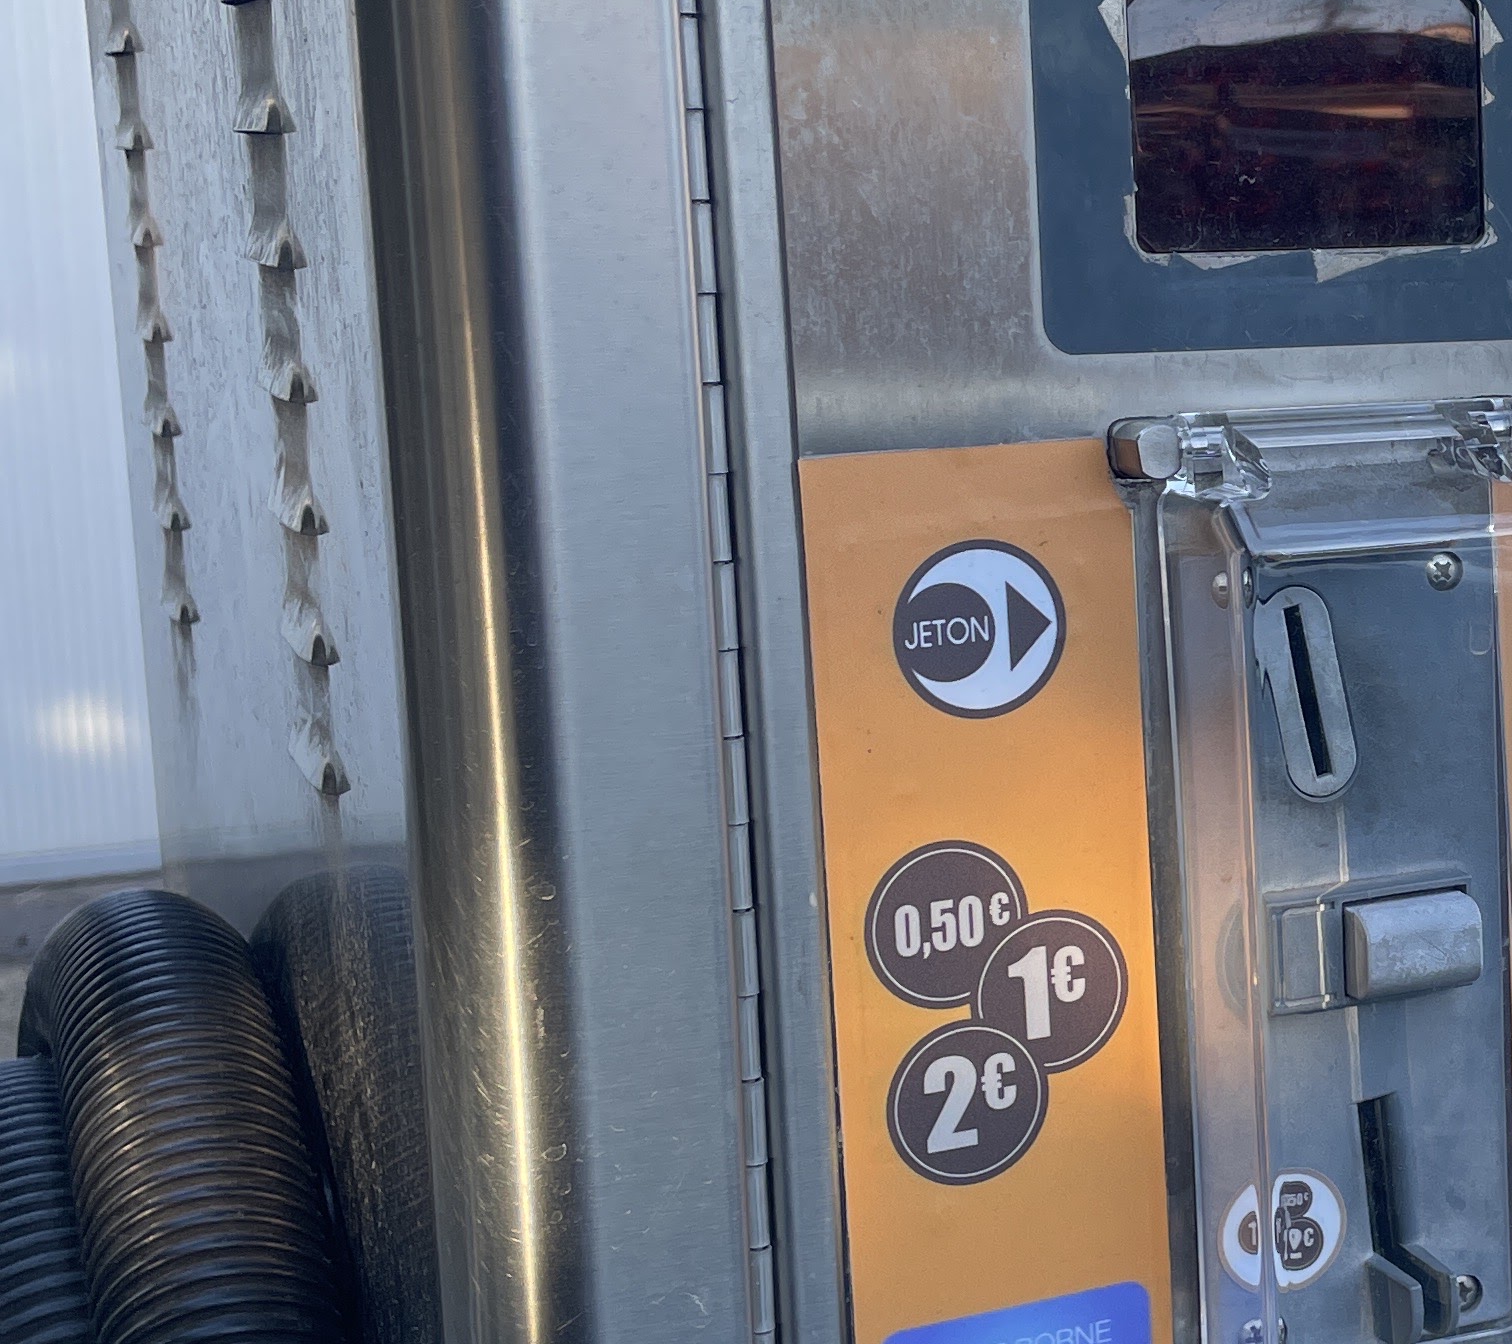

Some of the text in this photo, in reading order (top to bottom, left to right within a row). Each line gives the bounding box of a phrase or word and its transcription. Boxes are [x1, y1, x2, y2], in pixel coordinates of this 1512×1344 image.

[905, 616, 990, 649] JETON
[1007, 945, 1086, 1040] 1€
[923, 1052, 1017, 1154] 2€
